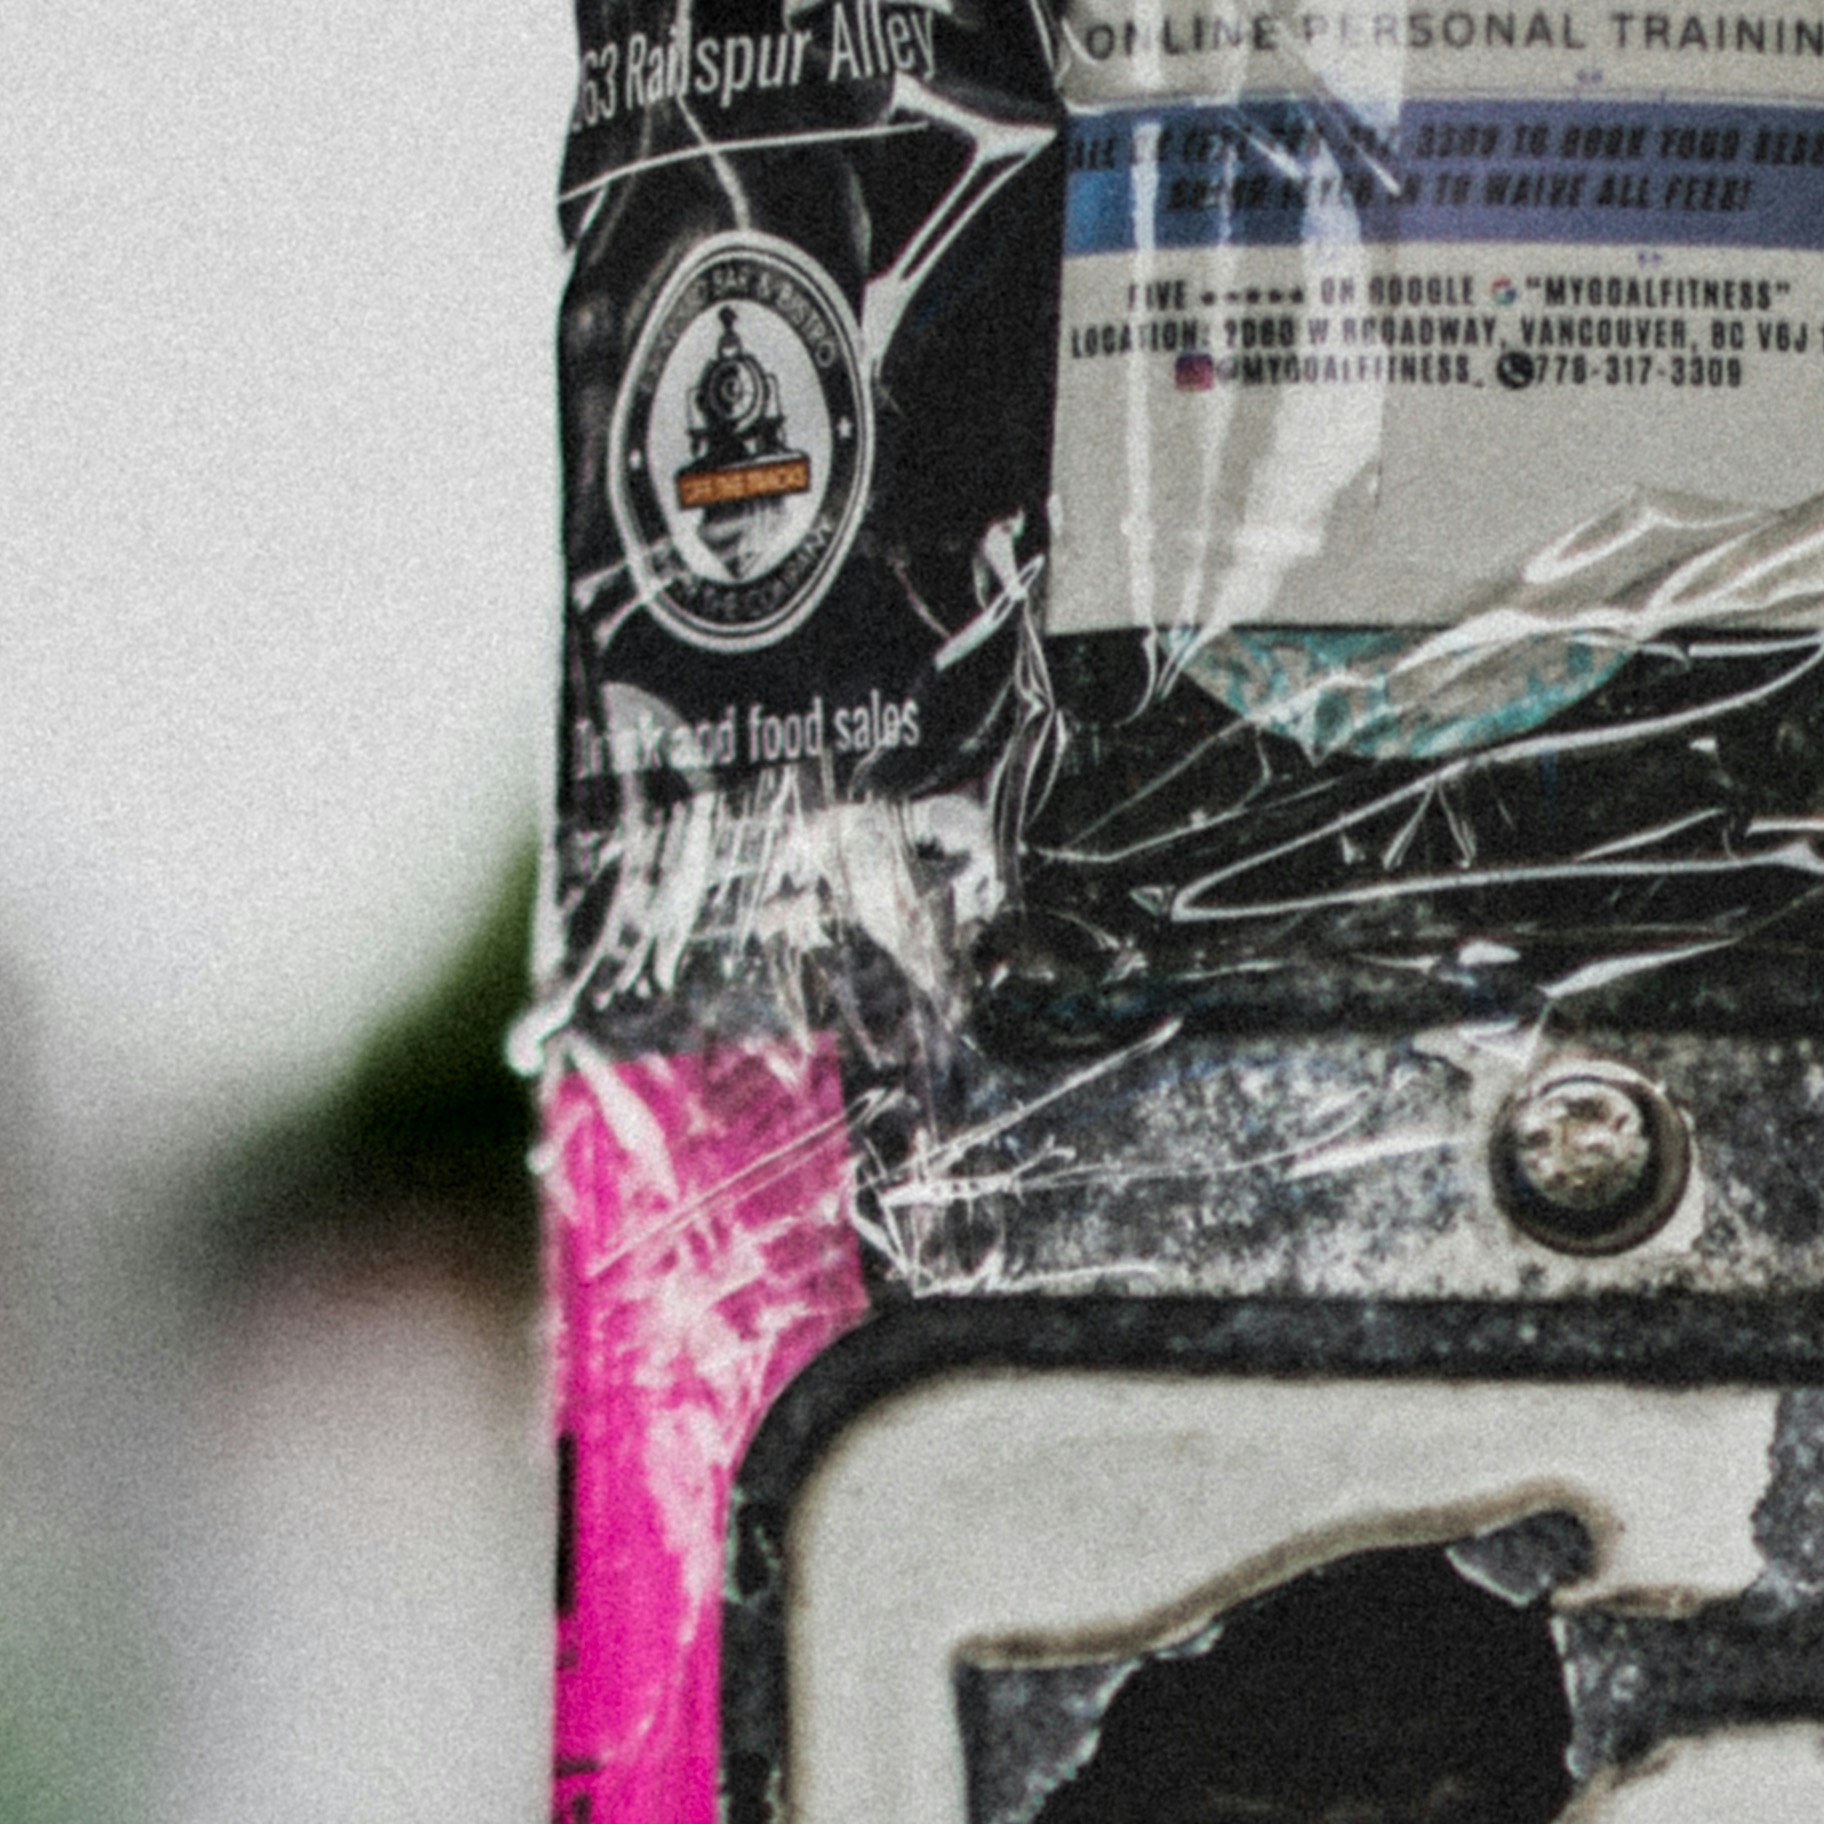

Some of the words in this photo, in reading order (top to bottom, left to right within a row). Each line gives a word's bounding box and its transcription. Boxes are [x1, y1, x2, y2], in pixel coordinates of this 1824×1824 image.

[1085, 12, 1279, 61] ONLINE
[1302, 10, 1587, 52] PERSONAL
[570, 40, 620, 132] 63
[827, 0, 937, 82] Alley
[1368, 273, 1475, 308] GOOGLE
[1307, 317, 1330, 347] W
[1519, 313, 1699, 354] VANCOUVER,
[1710, 319, 1745, 351] BC
[1756, 321, 1809, 354] V6J
[748, 696, 825, 764] food
[833, 688, 921, 754] sales
